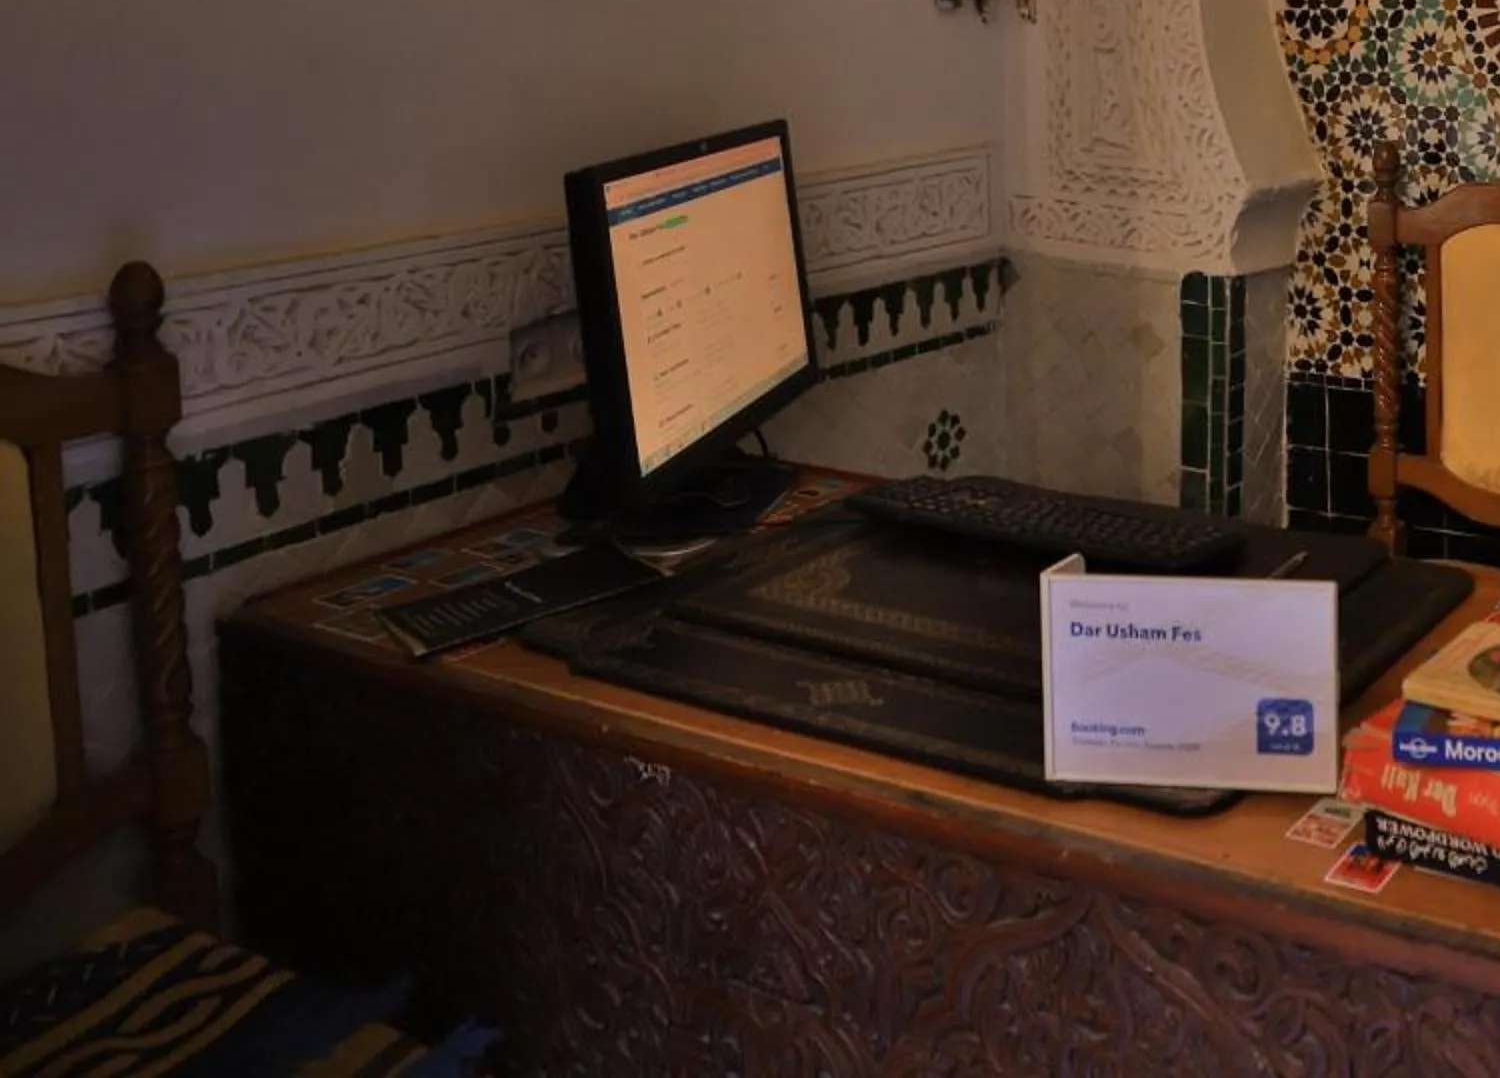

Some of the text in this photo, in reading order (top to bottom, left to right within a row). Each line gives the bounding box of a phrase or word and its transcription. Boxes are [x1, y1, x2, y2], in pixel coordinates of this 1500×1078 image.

[1070, 621, 1202, 642] Dar Usham Fes
[1263, 713, 1308, 737] 9.8
[1423, 777, 1457, 819] Der
[1375, 817, 1489, 856] WORDPOWER
